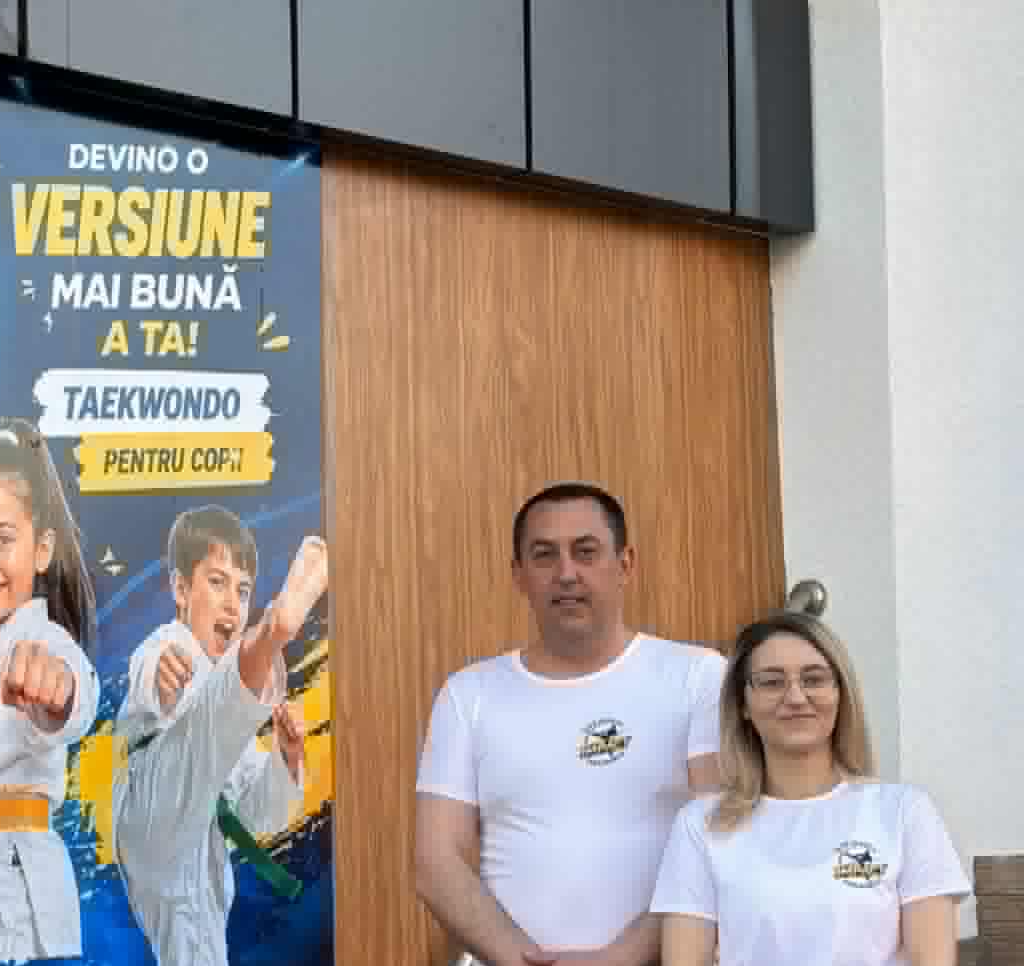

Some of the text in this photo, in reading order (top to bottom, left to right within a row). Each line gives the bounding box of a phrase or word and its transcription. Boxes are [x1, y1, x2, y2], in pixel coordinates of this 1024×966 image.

[68, 143, 209, 175] DEVINO O
[11, 182, 272, 260] VERSIUNE
[51, 263, 242, 311] MAI BUNĂ
[100, 320, 200, 358] A TA!
[63, 386, 241, 420] TAEKWONDO
[104, 447, 185, 476] PENTRU
